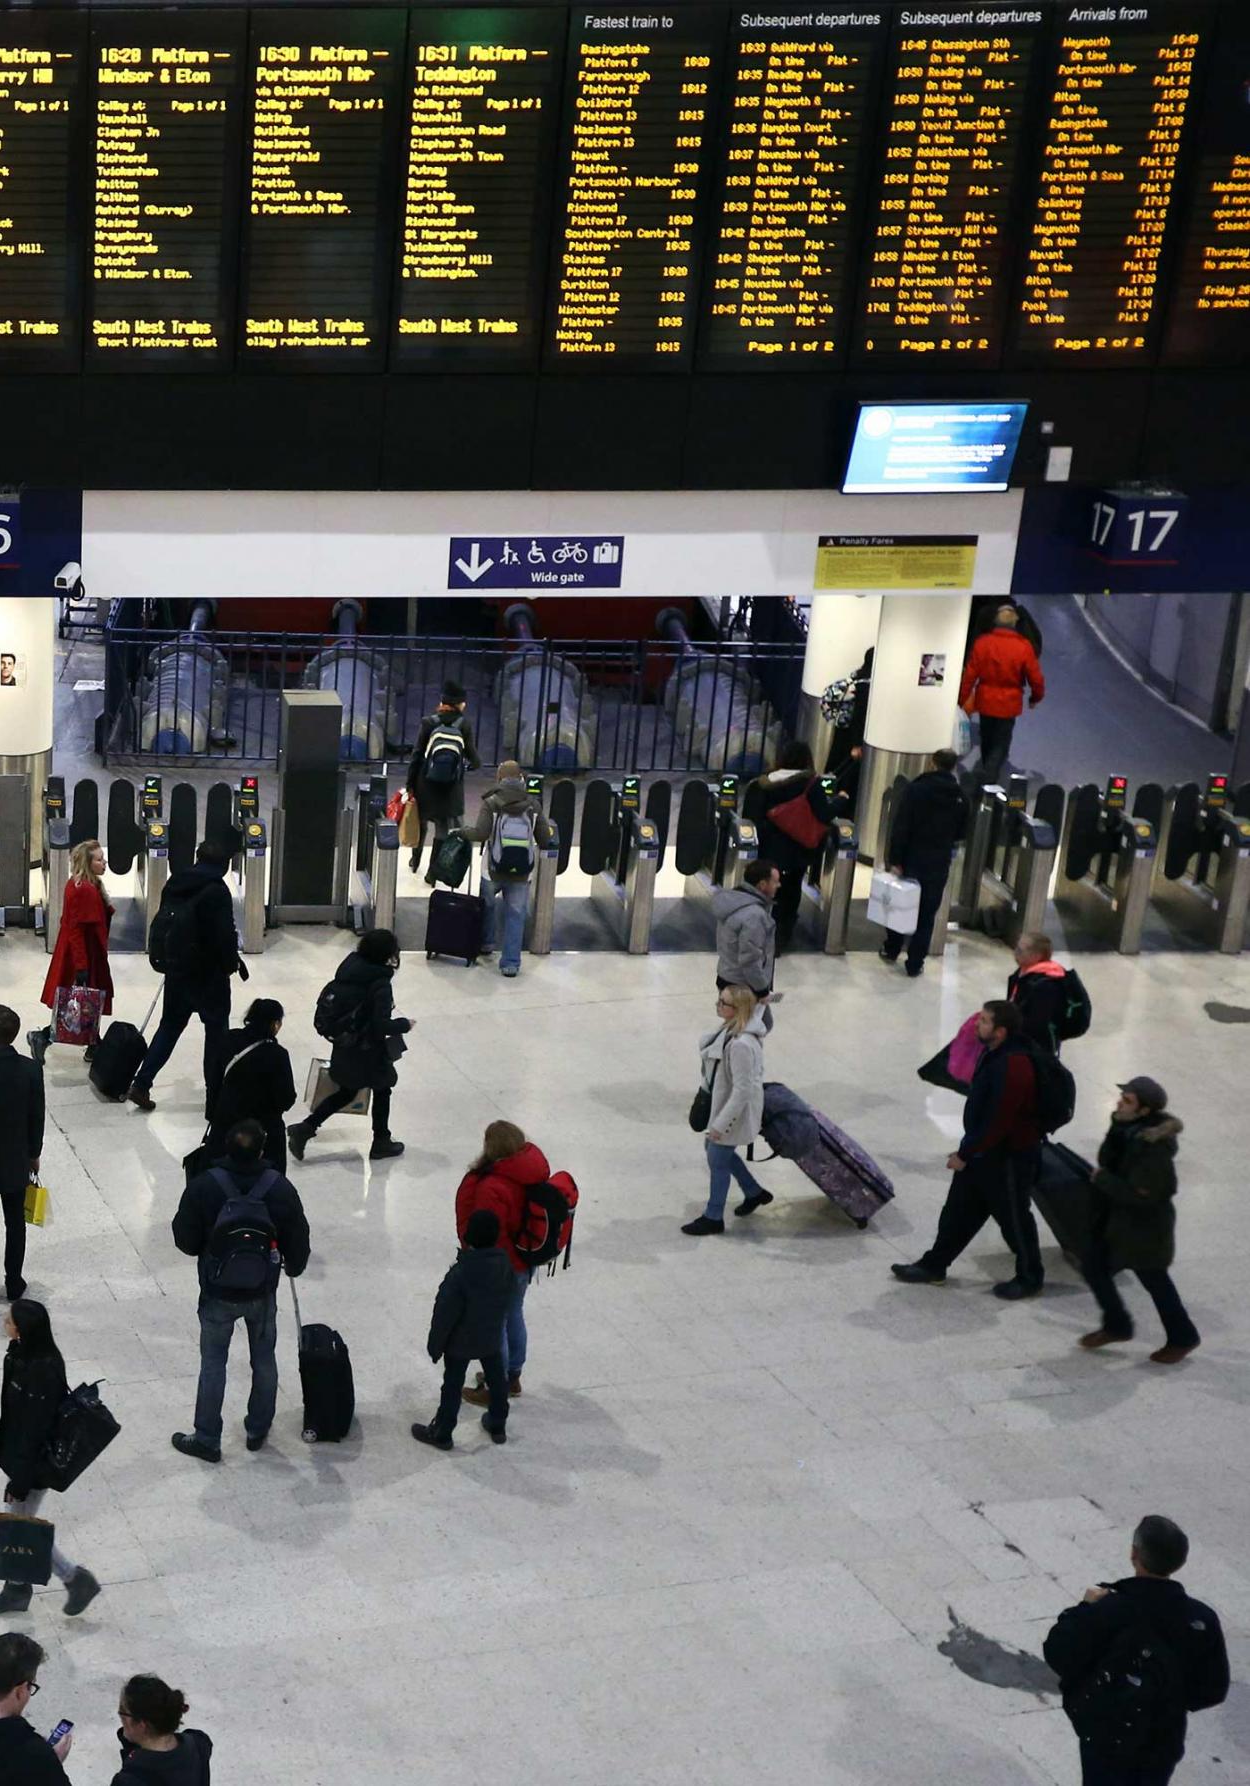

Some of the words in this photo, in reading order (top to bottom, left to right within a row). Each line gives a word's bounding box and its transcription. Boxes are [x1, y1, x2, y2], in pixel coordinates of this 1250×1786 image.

[584, 14, 629, 29] Fastest
[632, 14, 658, 29] train
[662, 14, 674, 29] to
[740, 12, 813, 29] Subsequent
[816, 12, 881, 29] departures
[900, 10, 973, 25] Subsequent
[976, 10, 1042, 25] departures
[1069, 6, 1116, 22] Arrivals
[1119, 6, 1147, 22] from
[581, 44, 650, 56] Basingstoke
[98, 68, 154, 83] Windsor
[176, 68, 210, 83] Eton
[257, 67, 342, 82] Portsmouth
[415, 66, 496, 83] Teddington
[578, 71, 650, 82] Farnborough
[563, 254, 606, 264] Staines
[748, 342, 783, 353] Page
[790, 341, 796, 351] 1
[802, 341, 818, 351] of
[824, 341, 834, 351] 2
[1055, 338, 1090, 350] Page
[1096, 338, 1107, 347] 2
[1112, 338, 1129, 347] of
[1134, 337, 1144, 347] 2
[1092, 502, 1116, 546] 17
[1128, 510, 1179, 551] 17
[872, 537, 894, 546] Fares
[531, 572, 558, 584] Wide
[560, 572, 585, 584] gate
